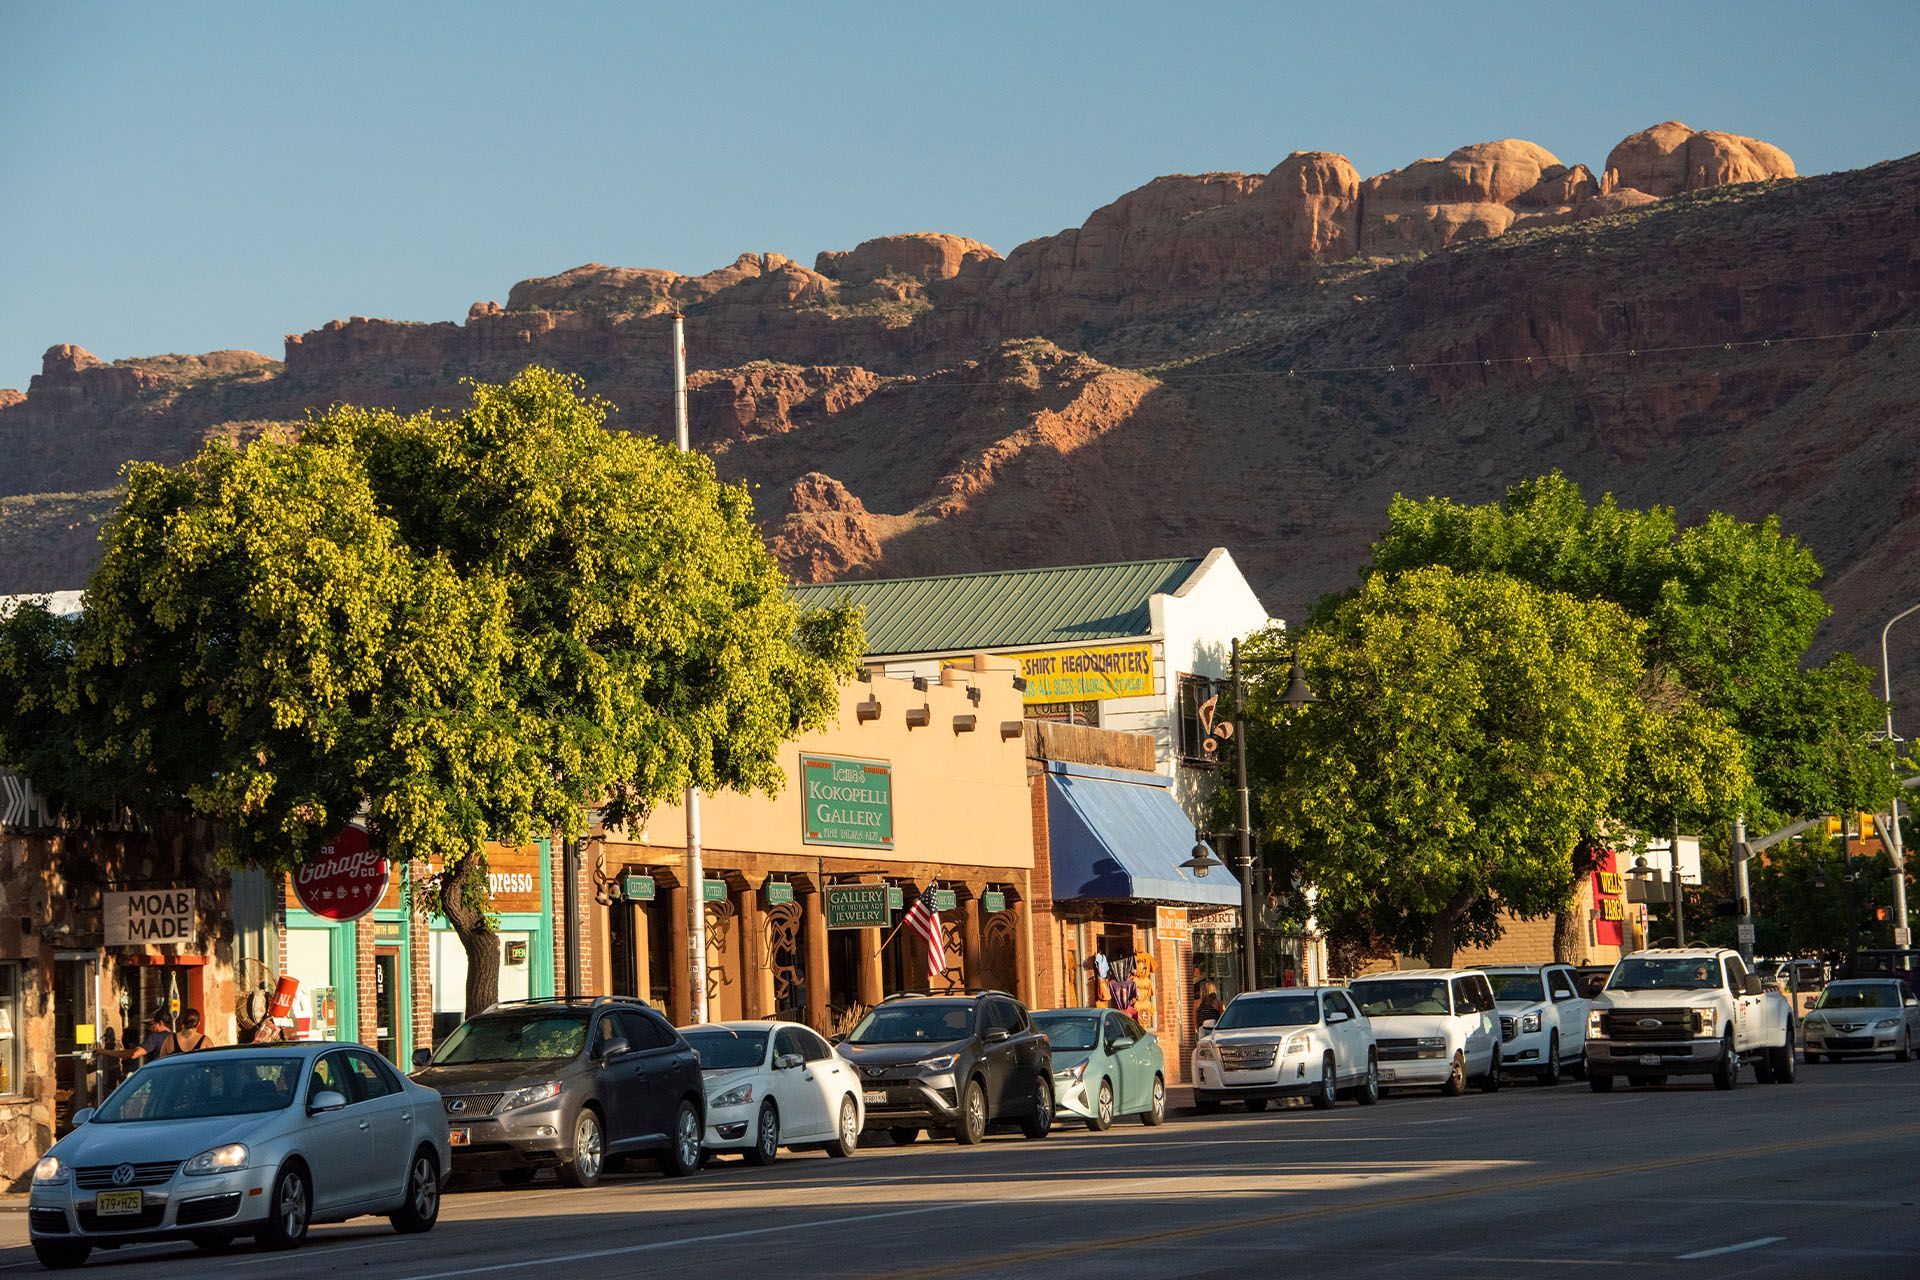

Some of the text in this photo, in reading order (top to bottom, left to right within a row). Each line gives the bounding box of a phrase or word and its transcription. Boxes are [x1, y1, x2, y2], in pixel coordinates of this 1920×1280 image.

[1022, 651, 1149, 676] -SHIRT HEADQUARTERS
[809, 781, 888, 805] KOKOPELLI
[817, 804, 882, 827] GALLERY
[840, 829, 863, 840] INDIAN
[865, 831, 879, 841] ART
[299, 851, 379, 884] Garage
[360, 867, 379, 877] CO.
[487, 872, 533, 900] presso
[1600, 872, 1623, 894] WELLS
[128, 893, 189, 916] MOAB
[831, 891, 883, 904] GALLERY
[836, 911, 880, 922] JEWELRY
[1190, 913, 1234, 923] ED DIRT
[1603, 899, 1625, 921] FARGO
[128, 917, 188, 940] MADE
[513, 949, 526, 957] OPEN
